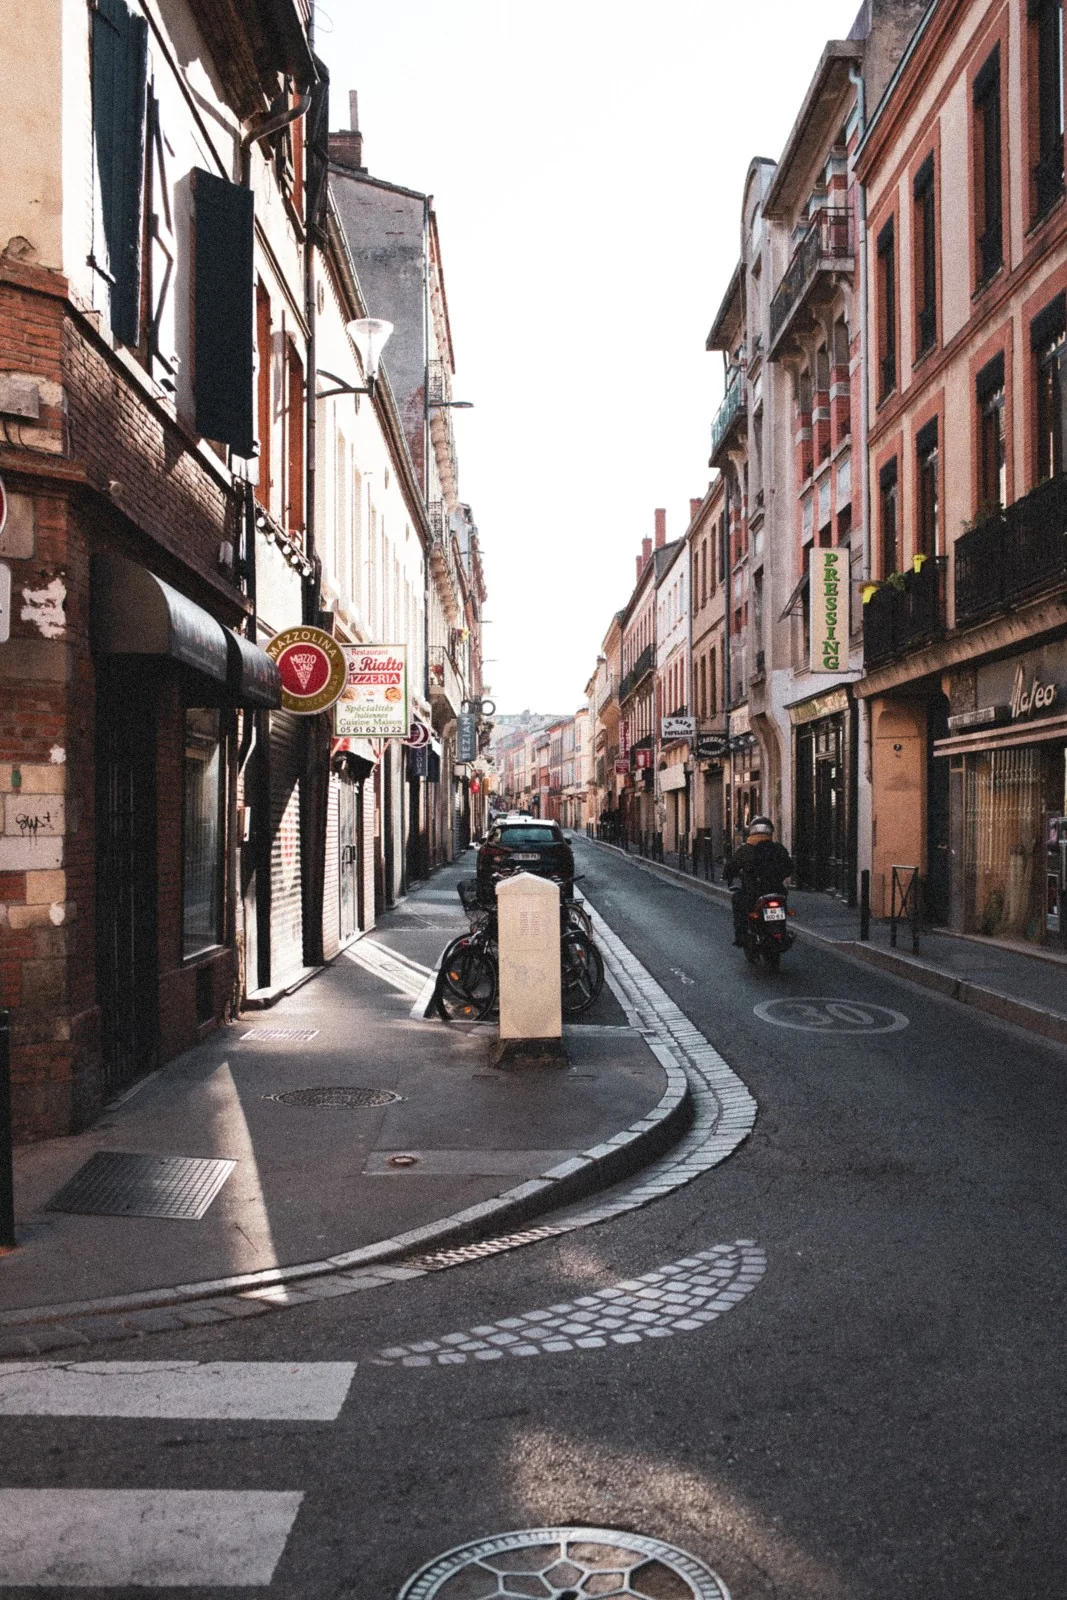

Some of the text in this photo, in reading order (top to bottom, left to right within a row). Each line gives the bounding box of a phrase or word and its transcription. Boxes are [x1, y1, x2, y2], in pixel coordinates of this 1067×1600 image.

[822, 552, 840, 670] PRESSING
[268, 631, 337, 658] MAZZOLINA
[351, 648, 389, 656] Restaurant
[359, 657, 404, 672] Rialto
[350, 673, 399, 684] IZZERIA
[345, 704, 394, 713] Spécialités
[339, 718, 403, 726] Cuisine Maison
[785, 1003, 875, 1025] 30
